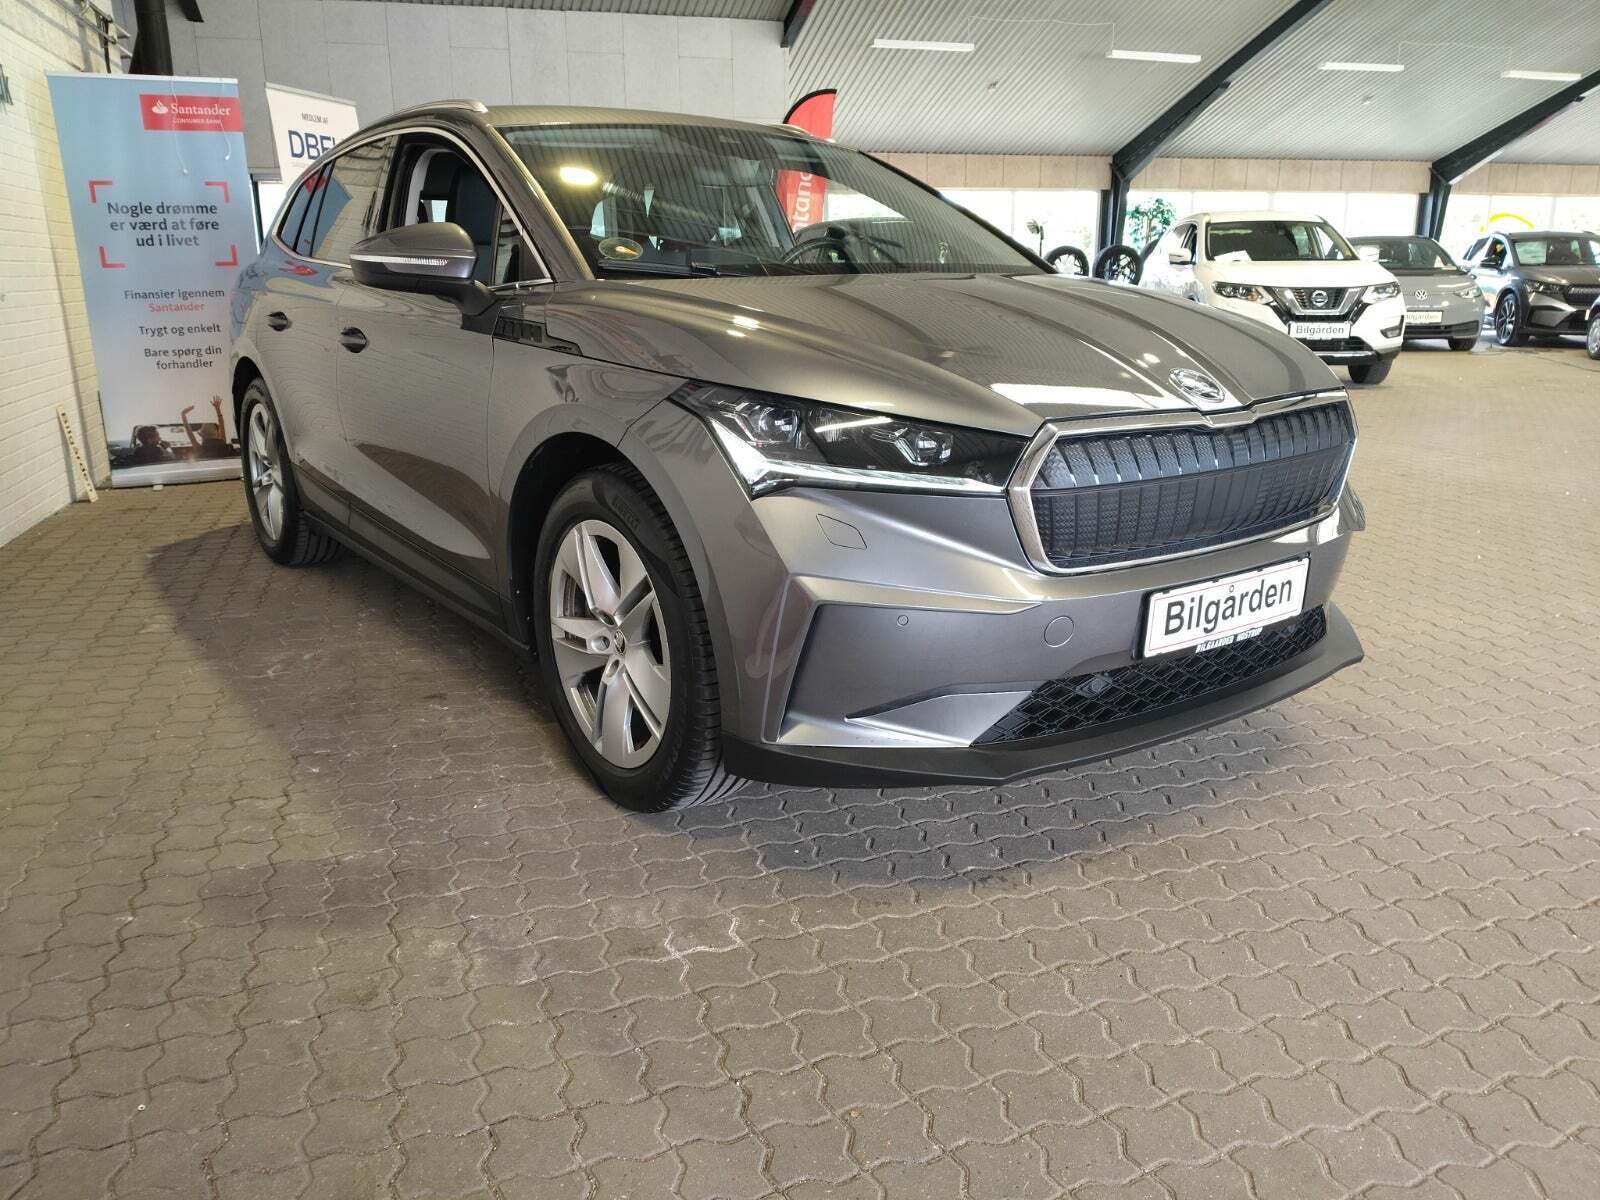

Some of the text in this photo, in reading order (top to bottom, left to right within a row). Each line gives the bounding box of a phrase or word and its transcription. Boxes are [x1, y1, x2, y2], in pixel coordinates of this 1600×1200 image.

[171, 103, 231, 116] Santander
[107, 202, 218, 218] Nogle drømme
[110, 218, 220, 231] er værd at føre
[136, 234, 200, 247] ud i livet
[124, 288, 225, 301] Finansier igennem
[148, 302, 205, 313] Santander
[139, 323, 222, 337] Trygt og enkelt
[1295, 325, 1344, 337] Bilgården
[144, 345, 223, 359] Bare spørg din
[156, 359, 213, 370] forhandler
[1164, 579, 1293, 634] Bilgården
